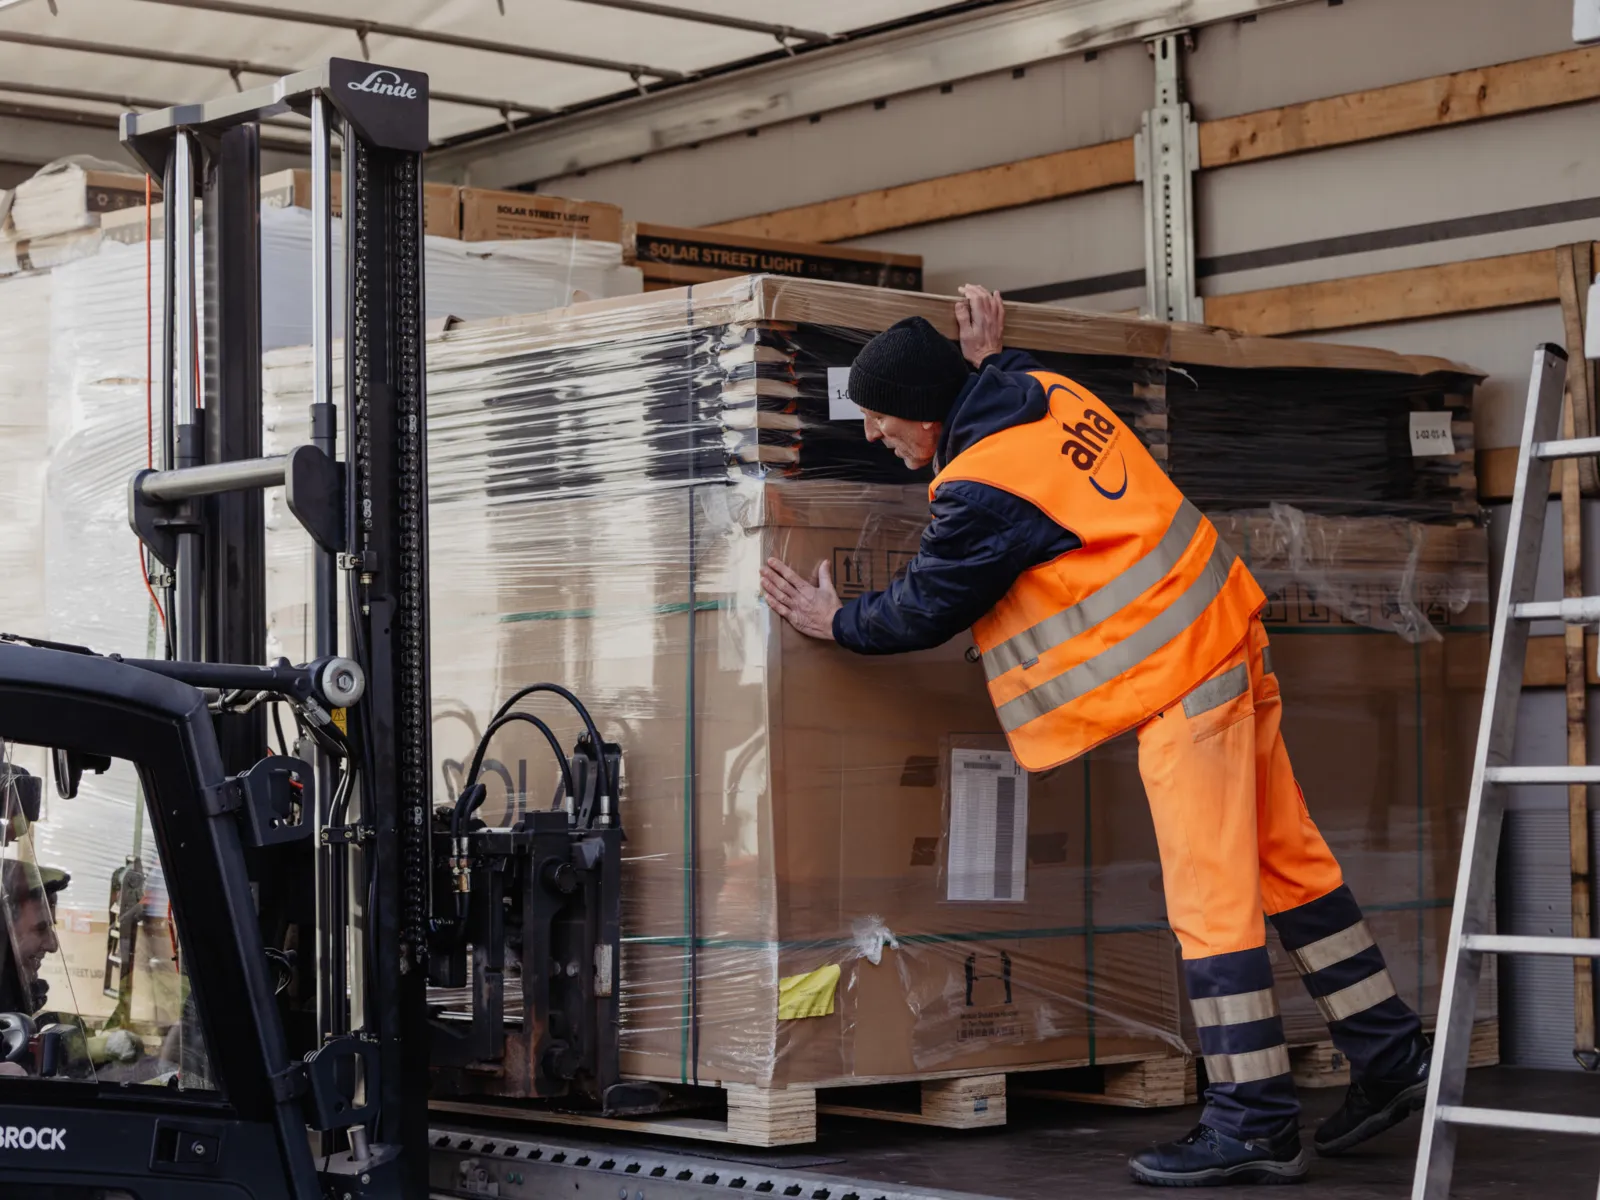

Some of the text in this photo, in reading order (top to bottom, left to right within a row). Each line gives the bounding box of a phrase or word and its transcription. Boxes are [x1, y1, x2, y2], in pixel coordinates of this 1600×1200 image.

[347, 70, 417, 99] Linde
[497, 205, 590, 223] SOLAR STREET LIGHT
[650, 242, 805, 273] SOLAR STREET LIGHT
[1061, 408, 1116, 471] aha
